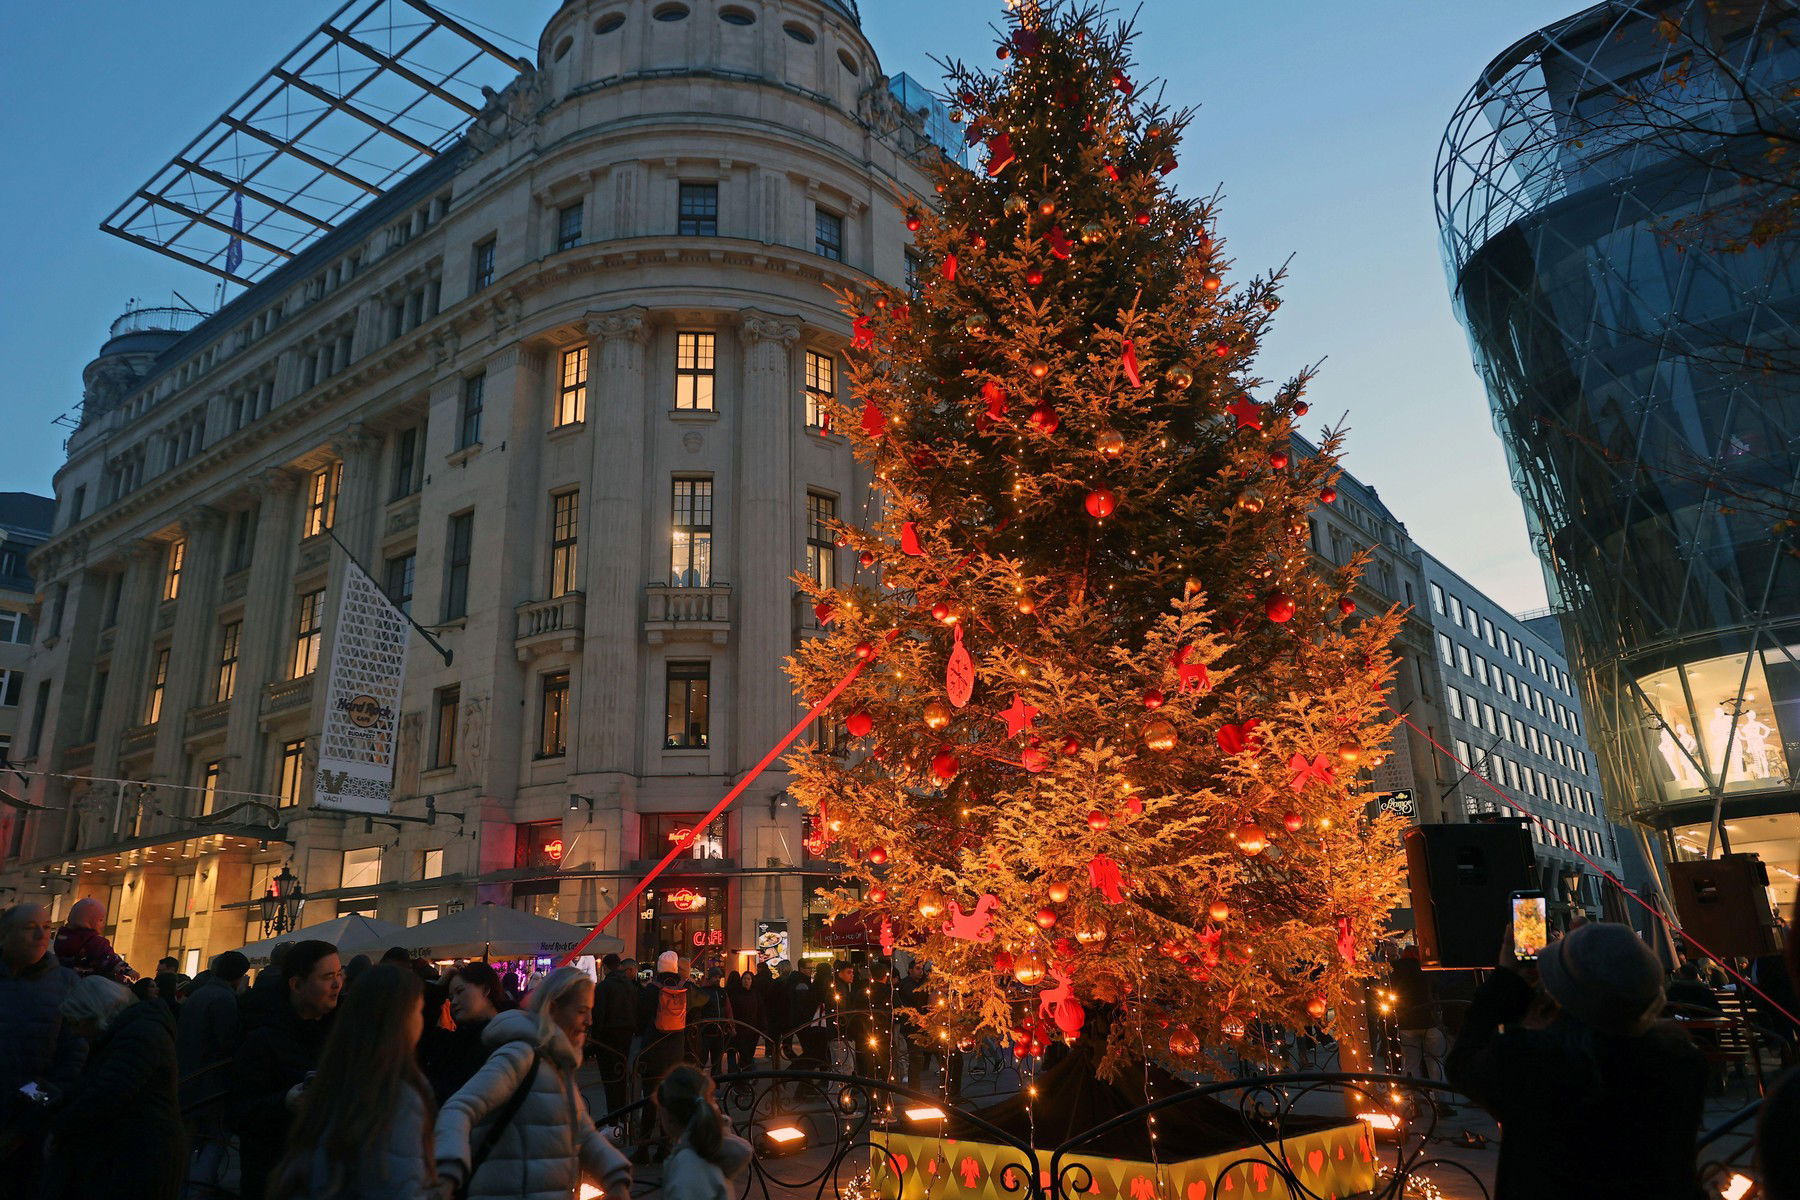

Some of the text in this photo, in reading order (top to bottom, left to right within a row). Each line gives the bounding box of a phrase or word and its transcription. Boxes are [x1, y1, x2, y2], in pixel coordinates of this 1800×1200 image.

[337, 697, 392, 719] Hard Rock
[348, 731, 376, 739] BUDAPEST
[667, 893, 684, 902] Hard
[540, 942, 555, 951] Hard
[555, 942, 567, 952] Rock
